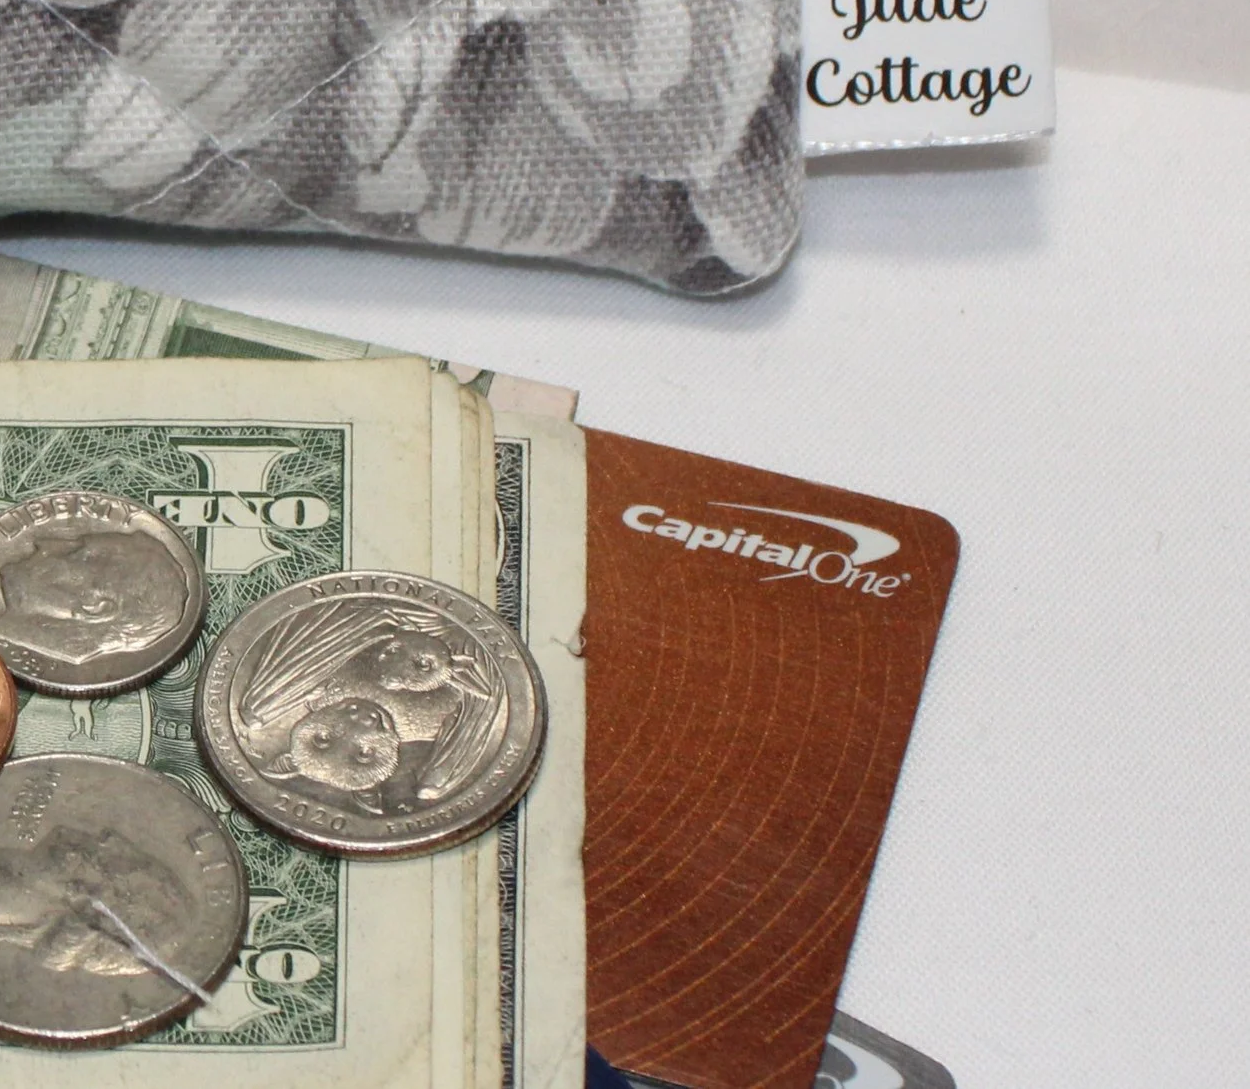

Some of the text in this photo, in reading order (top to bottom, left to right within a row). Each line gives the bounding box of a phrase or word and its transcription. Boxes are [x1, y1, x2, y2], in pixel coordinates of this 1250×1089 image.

[806, 57, 1031, 117] Cottage
[148, 490, 333, 530] ONE
[308, 575, 457, 612] NATIONAL
[273, 793, 348, 832] 2020
